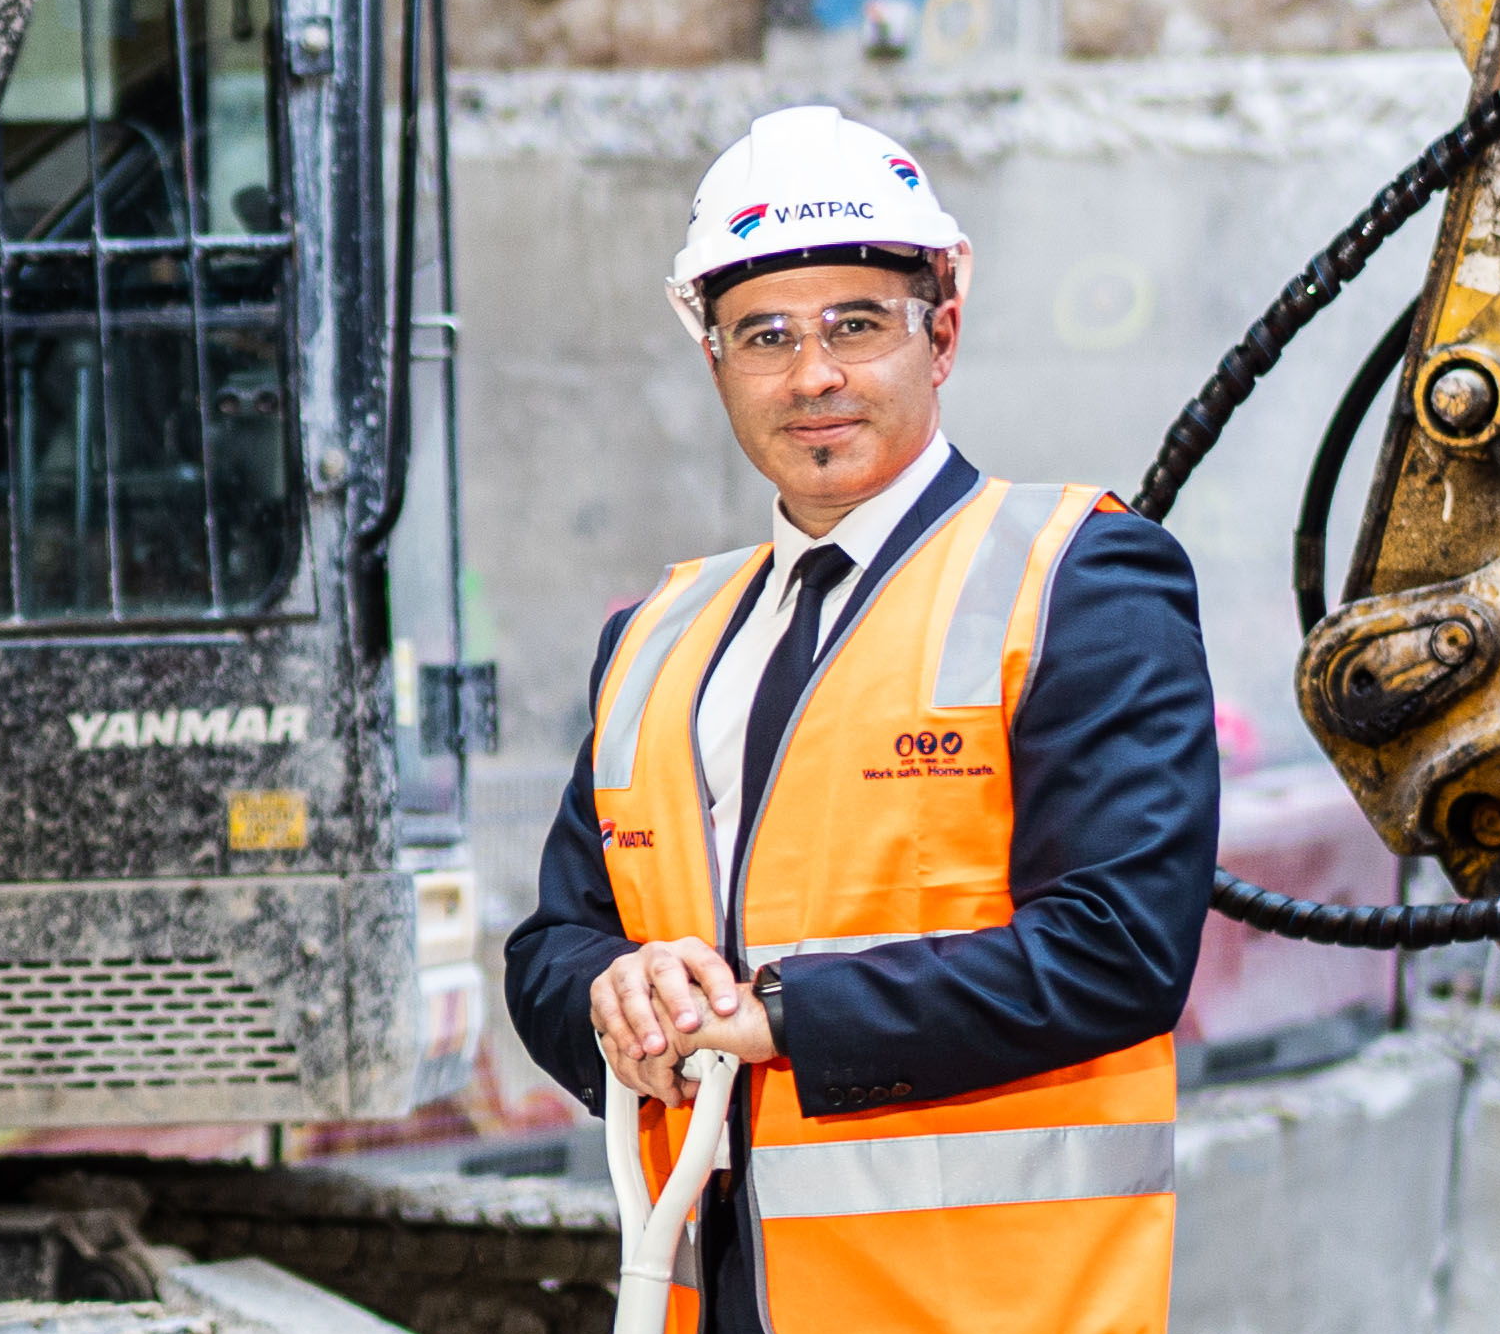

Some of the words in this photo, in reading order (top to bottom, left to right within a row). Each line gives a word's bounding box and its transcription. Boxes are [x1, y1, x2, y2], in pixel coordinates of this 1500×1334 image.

[774, 201, 875, 225] WATPAC
[67, 704, 310, 751] YANMAR
[863, 768, 893, 780] Work
[896, 765, 923, 778] safe.
[927, 765, 964, 776] Home
[966, 763, 995, 776] safe.
